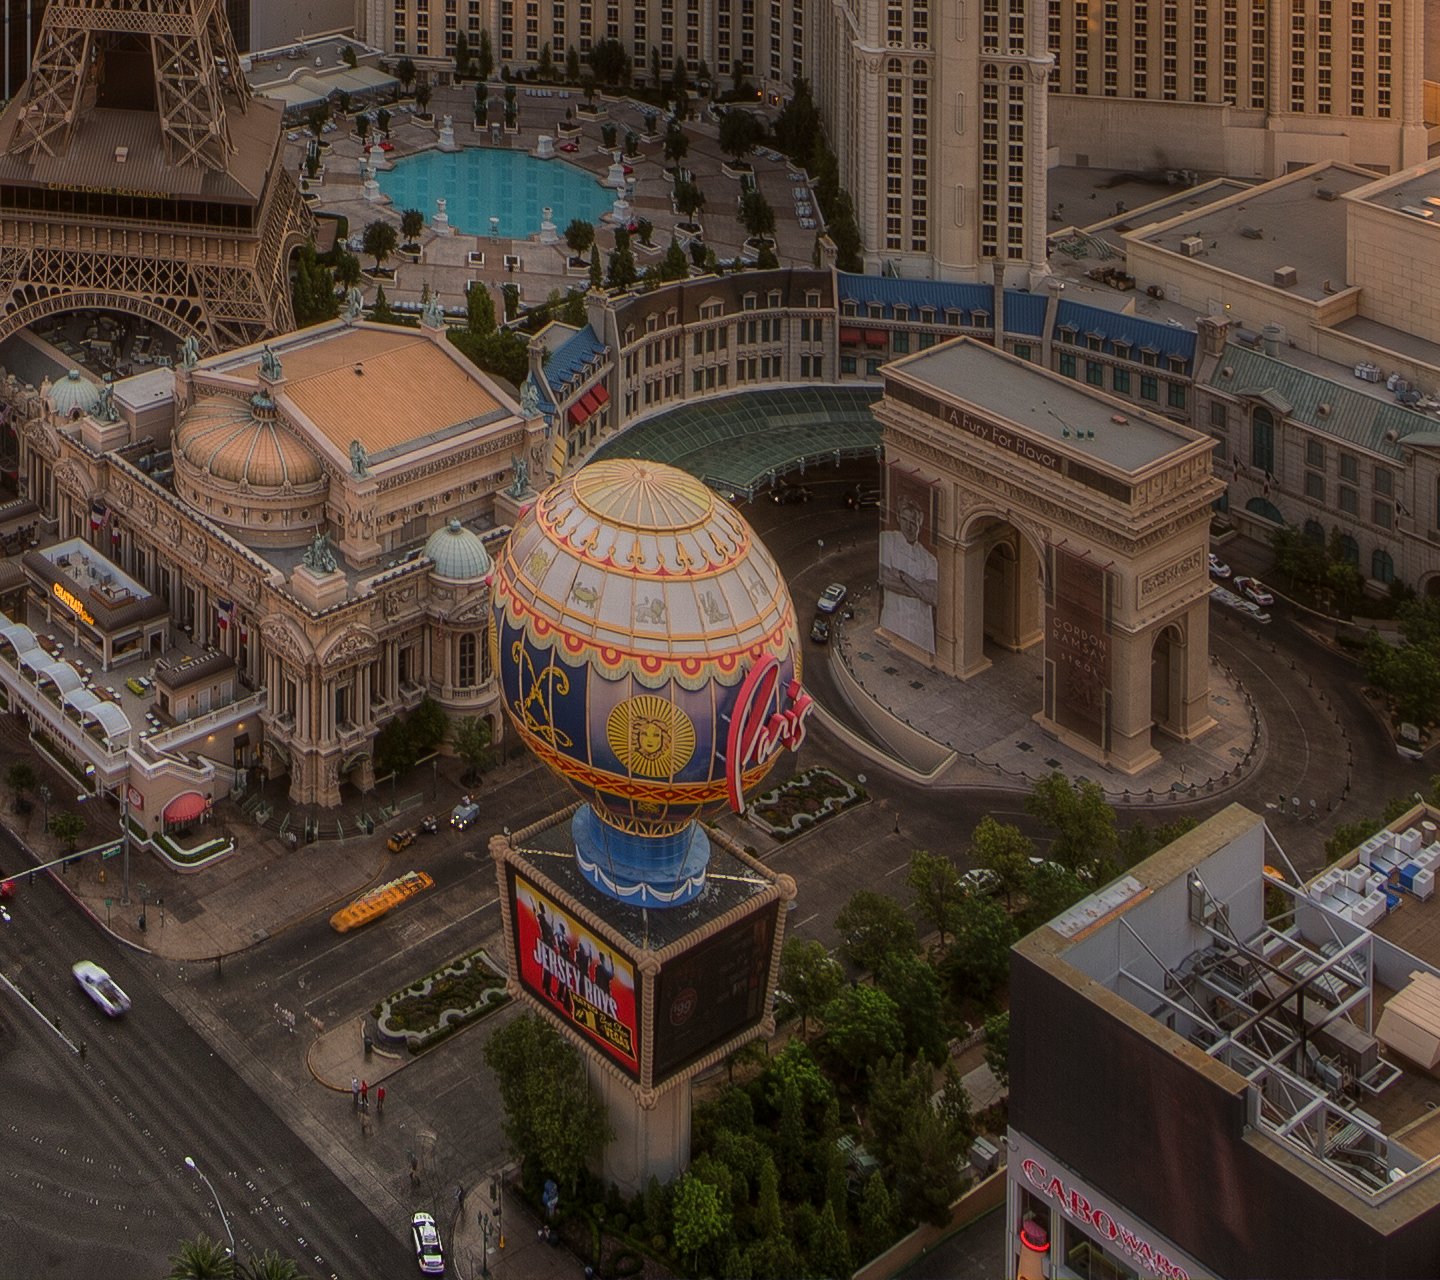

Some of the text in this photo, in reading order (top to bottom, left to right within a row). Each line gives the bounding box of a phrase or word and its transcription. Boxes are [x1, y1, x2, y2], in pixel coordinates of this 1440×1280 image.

[948, 410, 1057, 469] A Fury For Flavor
[1052, 629, 1107, 663] RAMSAY
[1053, 617, 1107, 652] GORDON
[726, 653, 815, 815] Paris
[533, 938, 619, 1021] JERSEY BOYS
[1022, 1158, 1119, 1241] CABO
